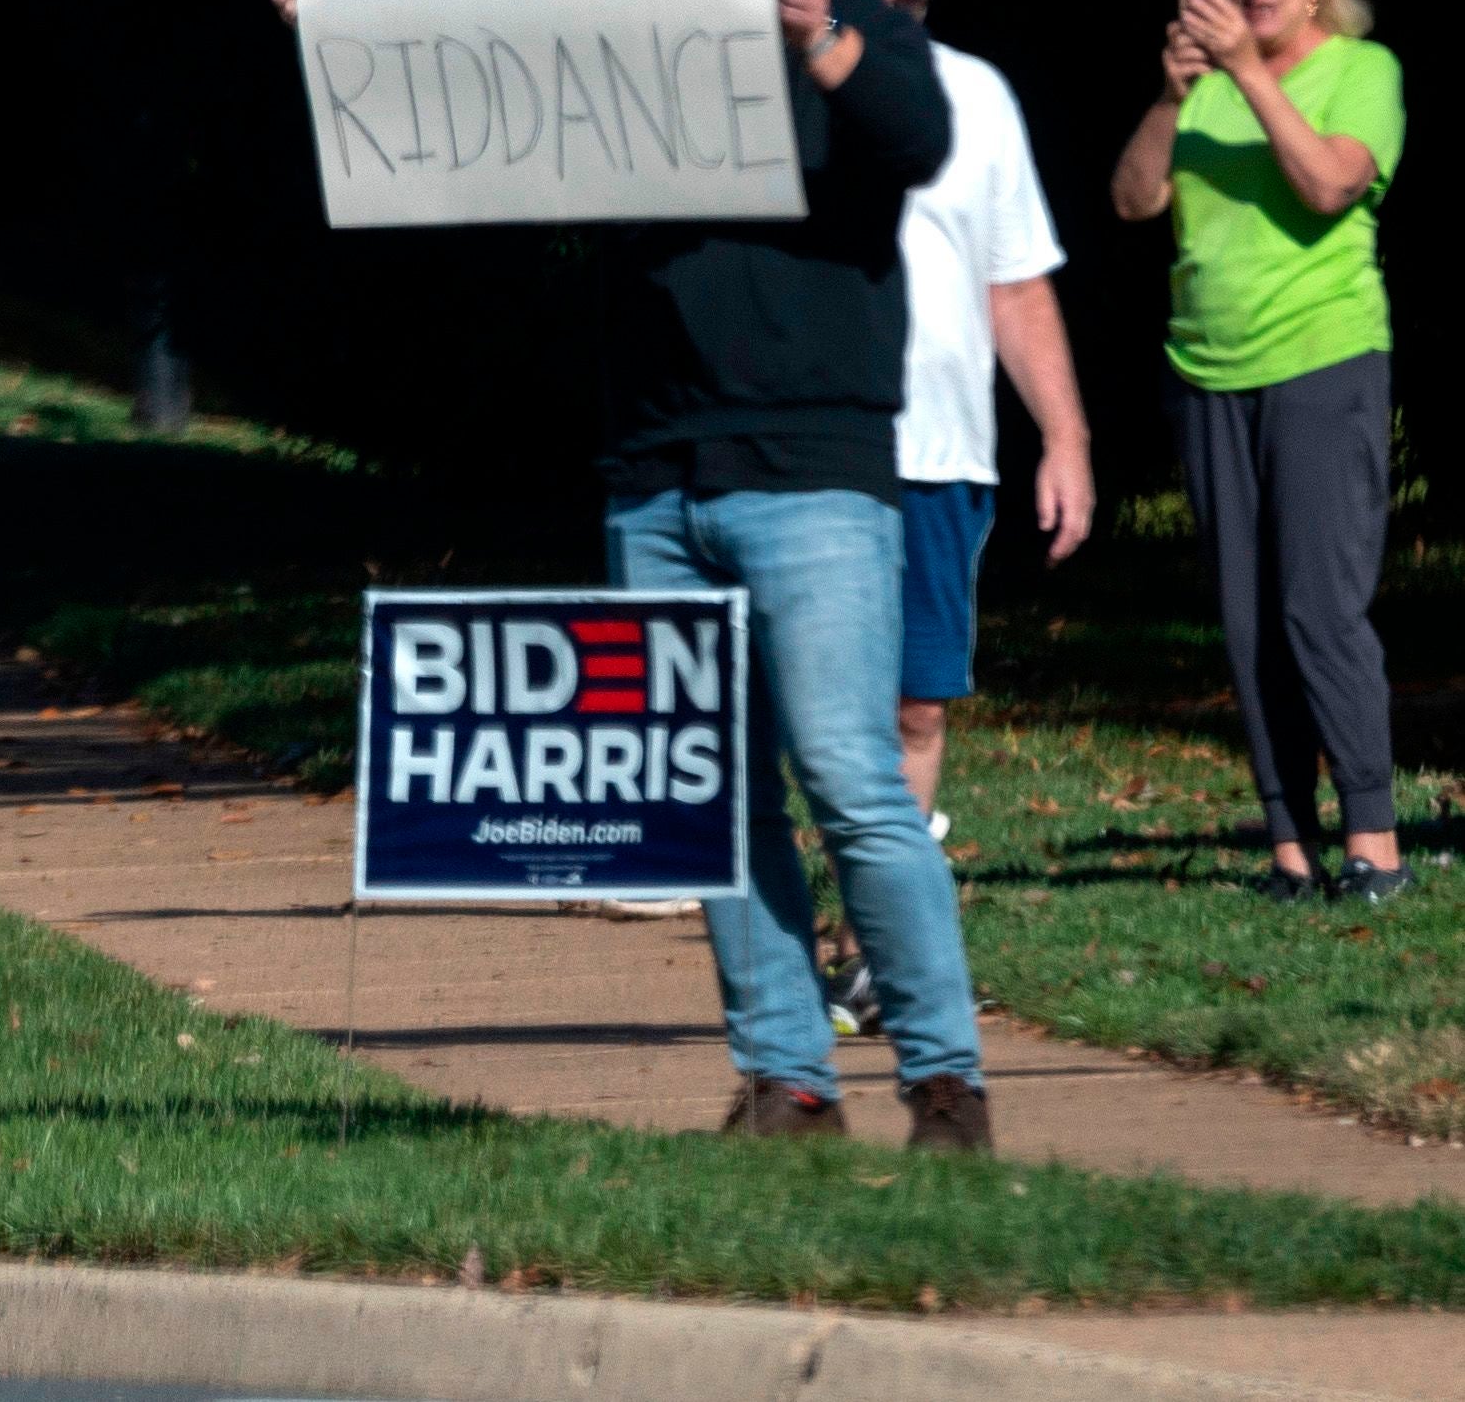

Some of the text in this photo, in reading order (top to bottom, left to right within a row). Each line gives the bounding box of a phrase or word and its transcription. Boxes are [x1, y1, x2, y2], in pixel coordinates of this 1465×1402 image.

[315, 24, 791, 181] RIDDANCE
[392, 620, 722, 716] BIDEN
[388, 724, 723, 805] HARRIS
[471, 816, 643, 845] JoeBiden.com
